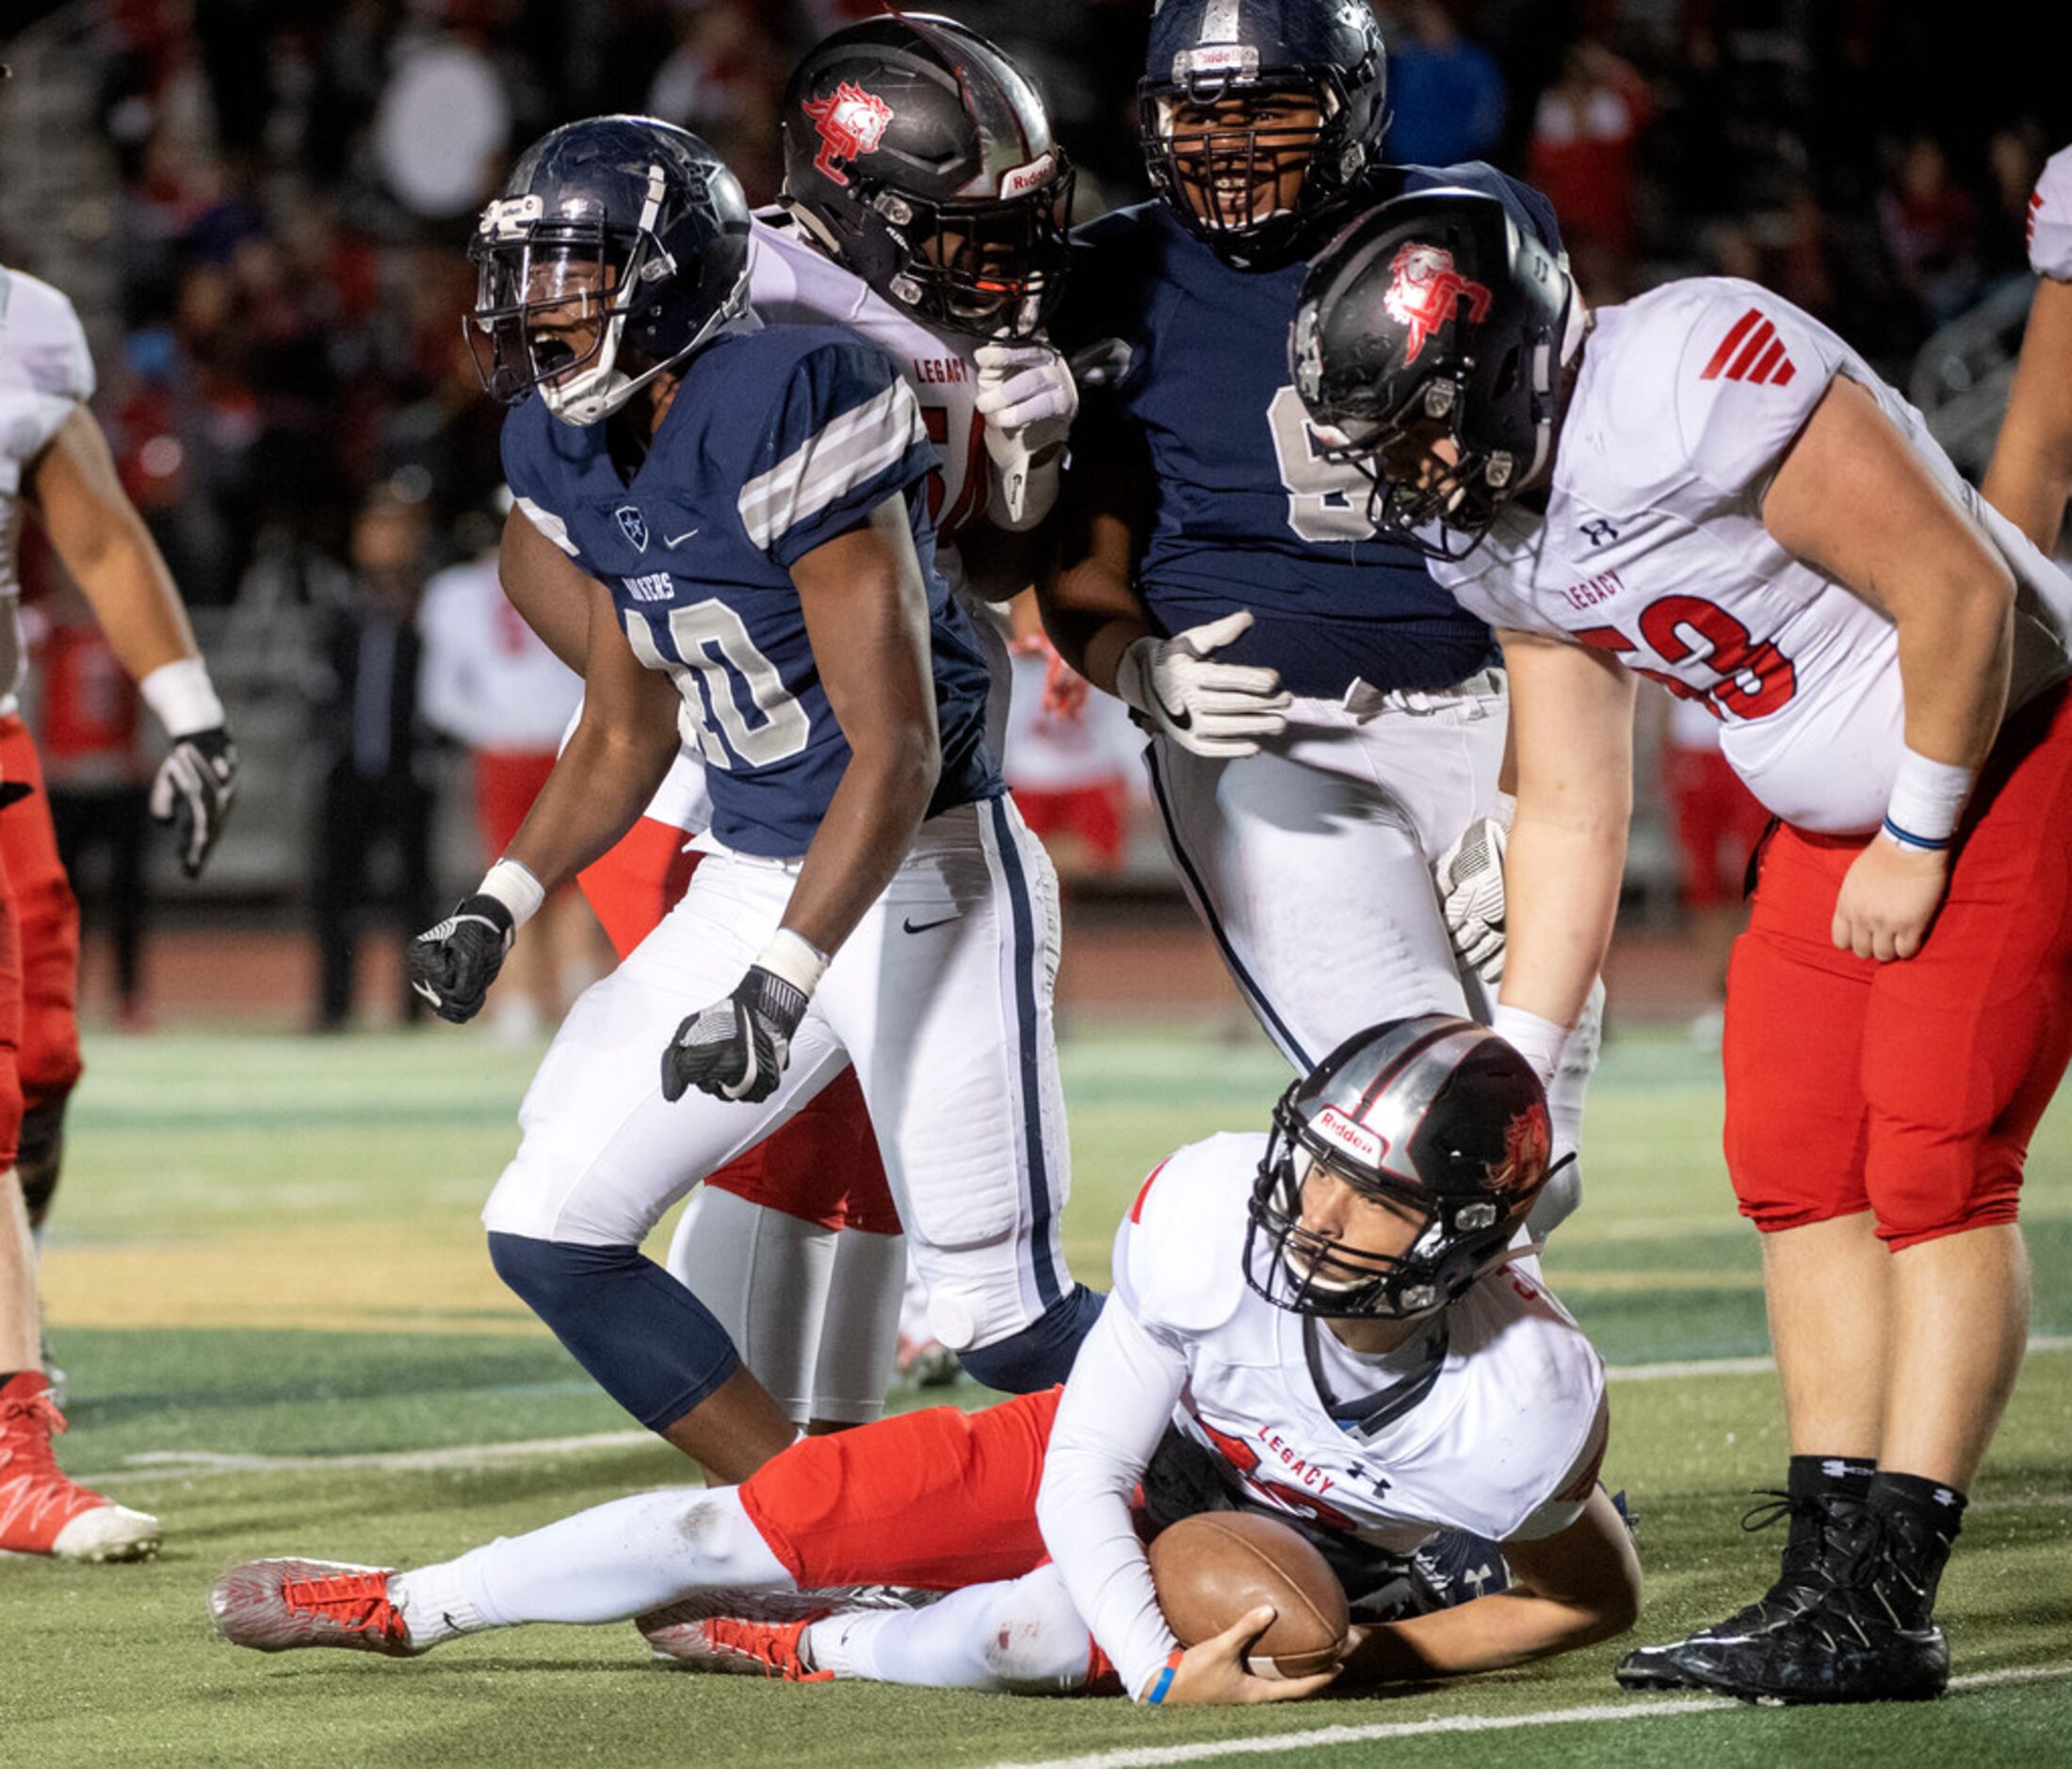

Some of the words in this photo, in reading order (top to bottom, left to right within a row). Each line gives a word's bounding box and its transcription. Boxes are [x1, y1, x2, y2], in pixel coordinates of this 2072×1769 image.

[914, 356, 968, 383] LEGACY
[1560, 568, 1626, 610] LEGACY
[1257, 1424, 1335, 1496] LEGACY
